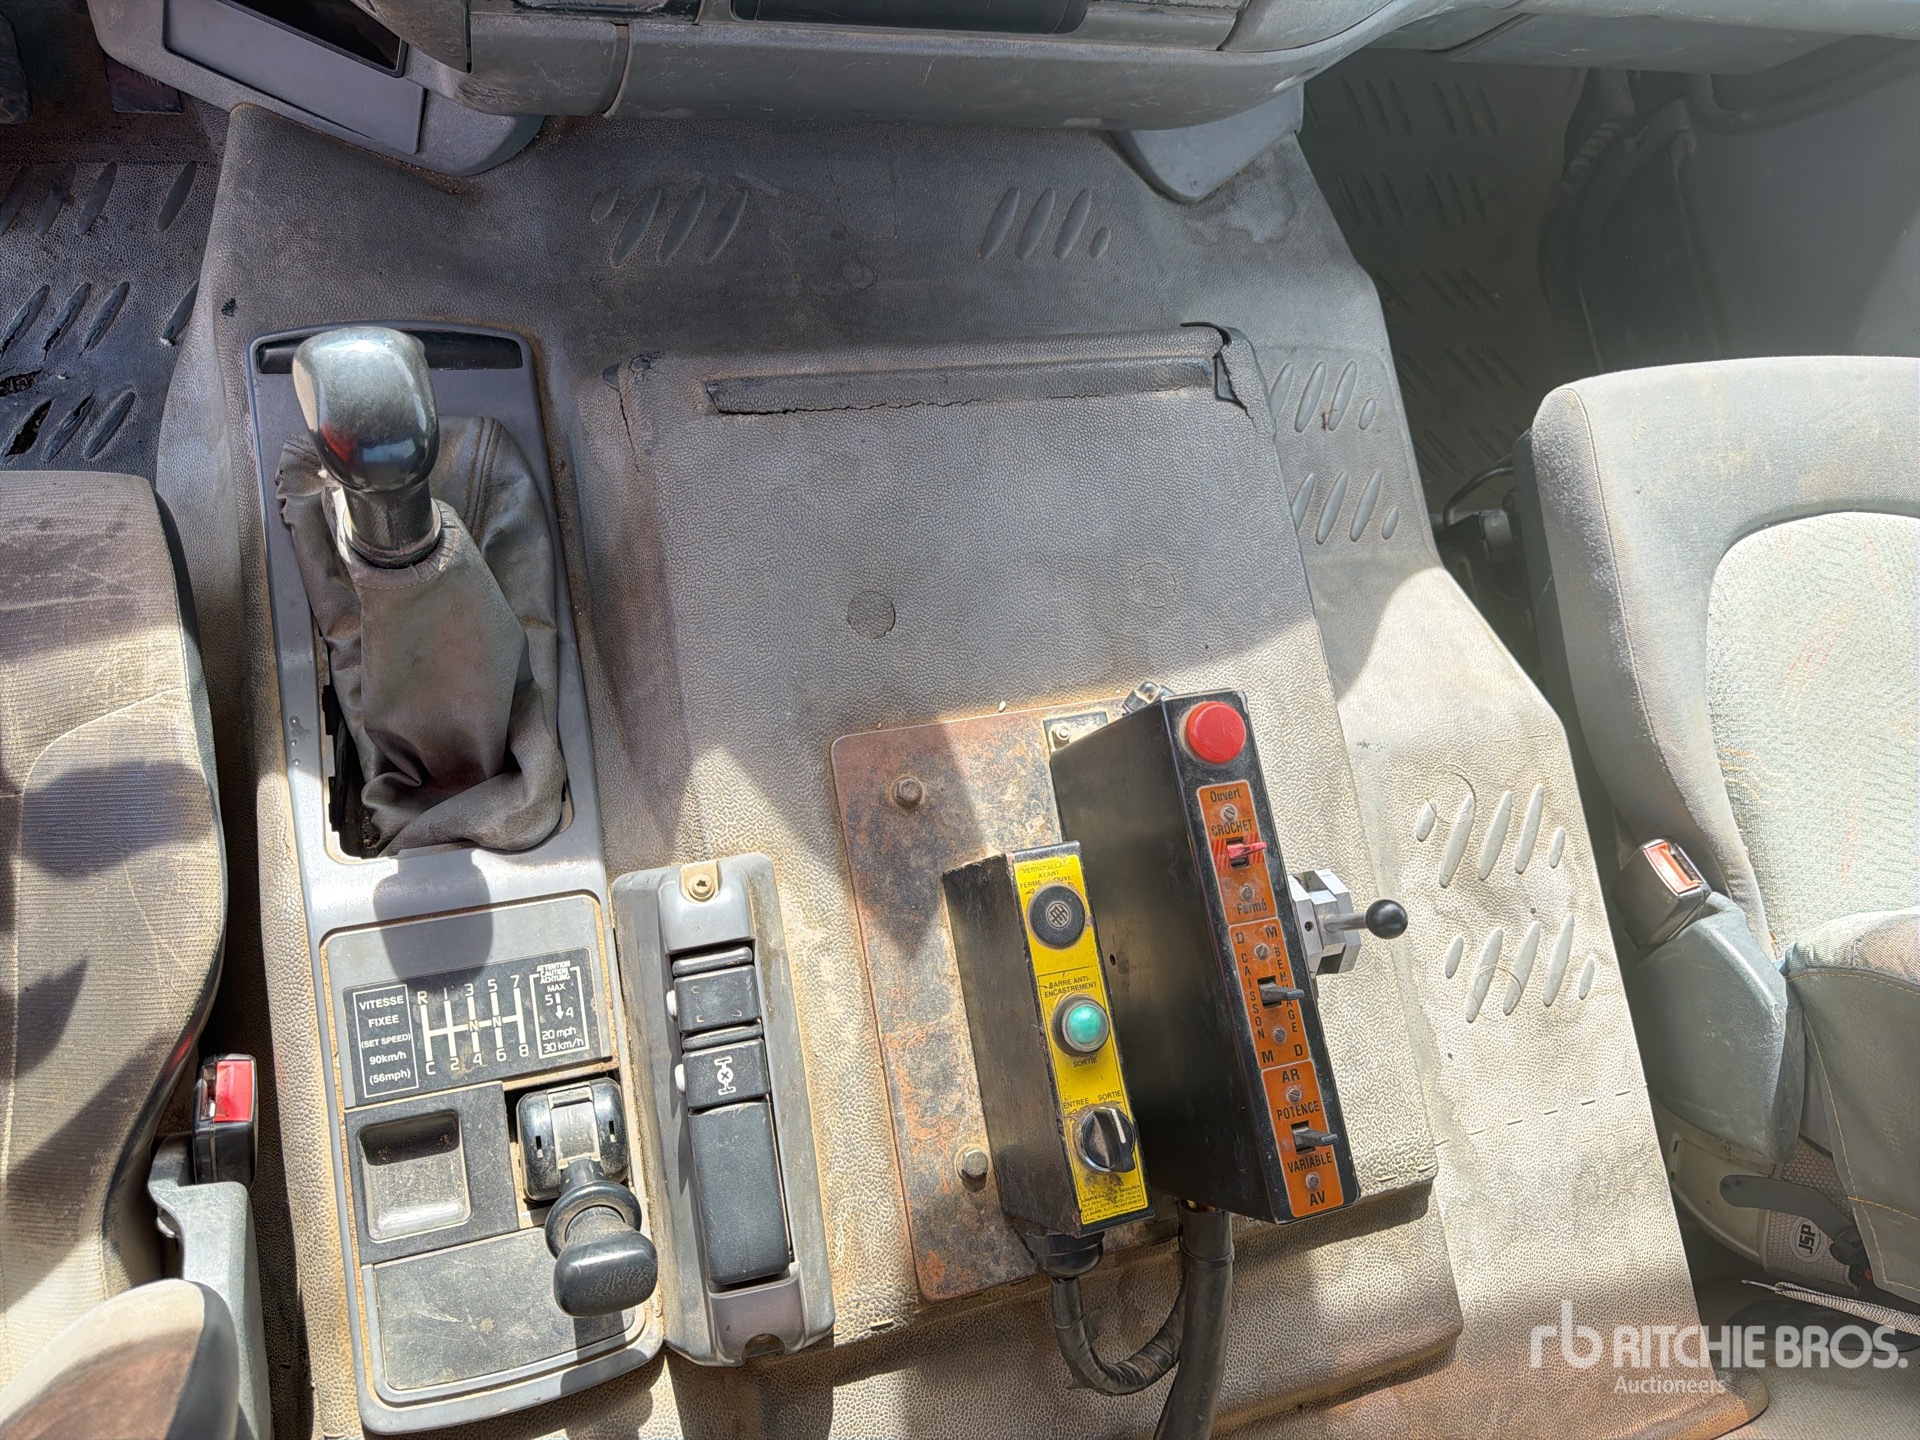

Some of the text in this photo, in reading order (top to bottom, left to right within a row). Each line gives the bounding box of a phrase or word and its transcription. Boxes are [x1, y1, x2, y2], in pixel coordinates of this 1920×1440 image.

[1210, 788, 1241, 803] Ouvert
[1212, 819, 1253, 837] CROCHET
[1038, 870, 1059, 879] AVANT
[1236, 899, 1268, 915] Fermé
[1235, 931, 1245, 945] D
[1265, 925, 1278, 939] M
[488, 979, 498, 992] 5
[510, 975, 520, 988] 7
[546, 982, 566, 993] MAX
[1048, 975, 1091, 989] BARRE ANTI-
[464, 983, 474, 997] 3
[1044, 981, 1098, 998] ENCASTREMENT
[1241, 953, 1265, 1040] CAISSON
[359, 995, 405, 1011] VITESSE
[417, 991, 428, 1005] R
[544, 994, 554, 1006] 5
[565, 1006, 574, 1018] 4
[368, 1015, 400, 1028] FIXEE
[469, 1020, 480, 1032] N
[492, 1016, 502, 1028] N
[541, 1026, 576, 1041] 20 mph
[361, 1033, 411, 1050] (SET SPEED)
[543, 1038, 584, 1054] 30 km/h
[496, 1048, 507, 1062] 6
[519, 1045, 529, 1057] 8
[1261, 1050, 1275, 1064] M
[1293, 1044, 1304, 1057] D
[369, 1052, 407, 1066] 90km/h
[450, 1058, 460, 1071] 2
[472, 1053, 483, 1066] 4
[1072, 1057, 1098, 1068] SORTIE
[426, 1062, 436, 1076] C
[1282, 1068, 1300, 1084] AR
[369, 1069, 411, 1085] (56mph)
[1097, 1090, 1122, 1102] SORTIE
[1276, 1101, 1320, 1121] POTENCE
[1287, 1153, 1332, 1173] VARIABLE
[1309, 1190, 1326, 1206] AV
